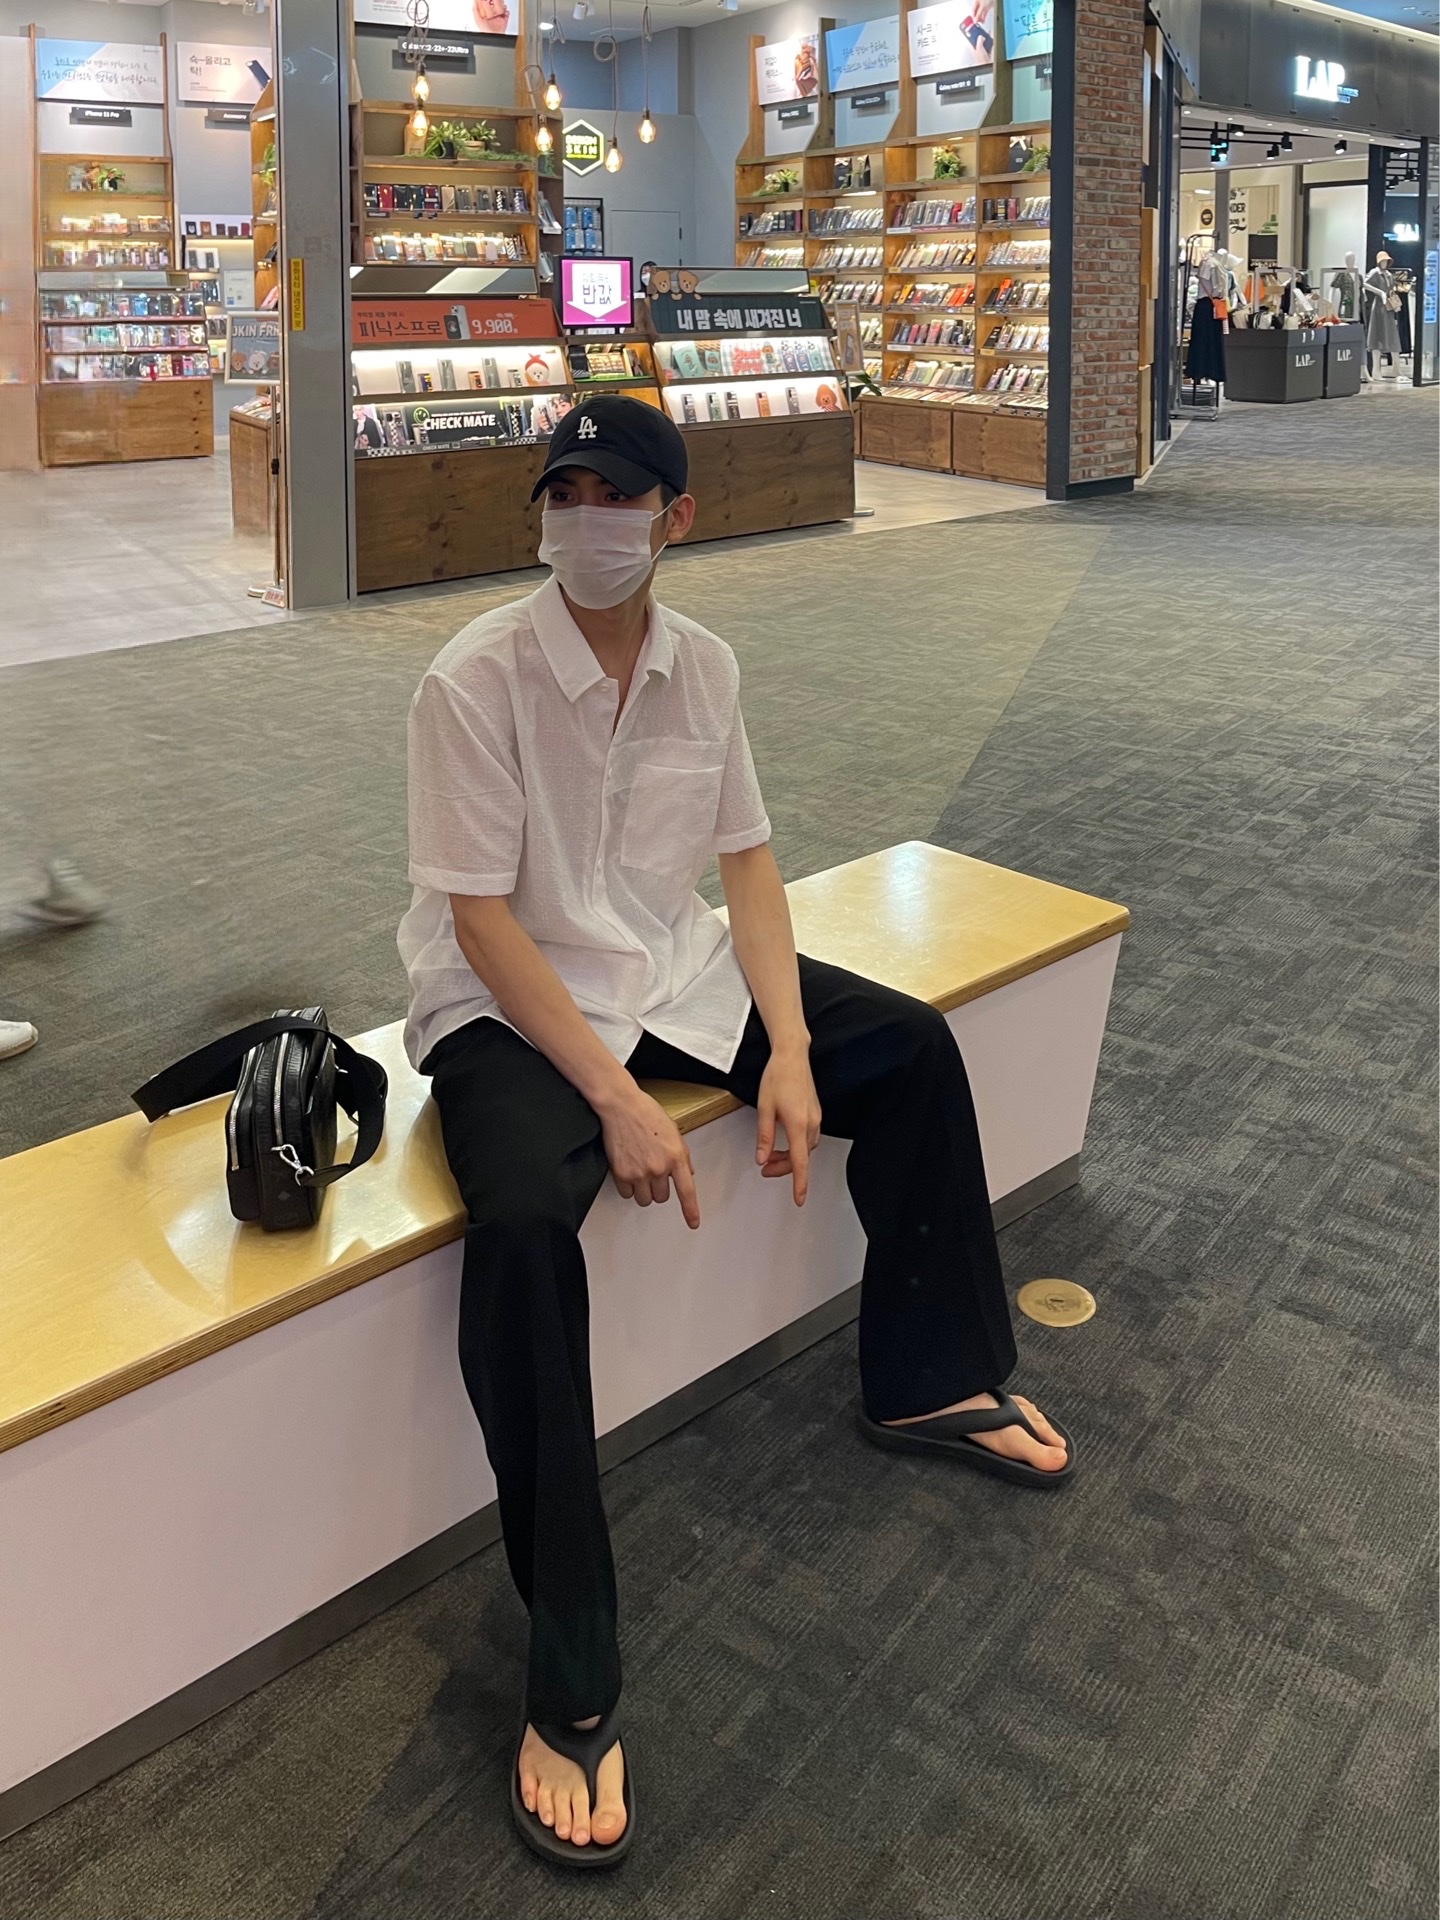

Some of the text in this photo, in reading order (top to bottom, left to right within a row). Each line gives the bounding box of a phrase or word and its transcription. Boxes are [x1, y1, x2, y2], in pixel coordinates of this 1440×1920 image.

[1294, 55, 1345, 102] LAP
[565, 144, 598, 155] SKIN
[583, 284, 612, 305] 반값
[676, 308, 803, 330] 내 맘 속에 새겨진 너
[359, 320, 443, 337] 피닉스프로
[1296, 353, 1311, 367] LAP
[1337, 349, 1351, 362] LAP
[423, 416, 462, 431] CHECK
[463, 414, 496, 428] MATE
[577, 416, 598, 440] LA
